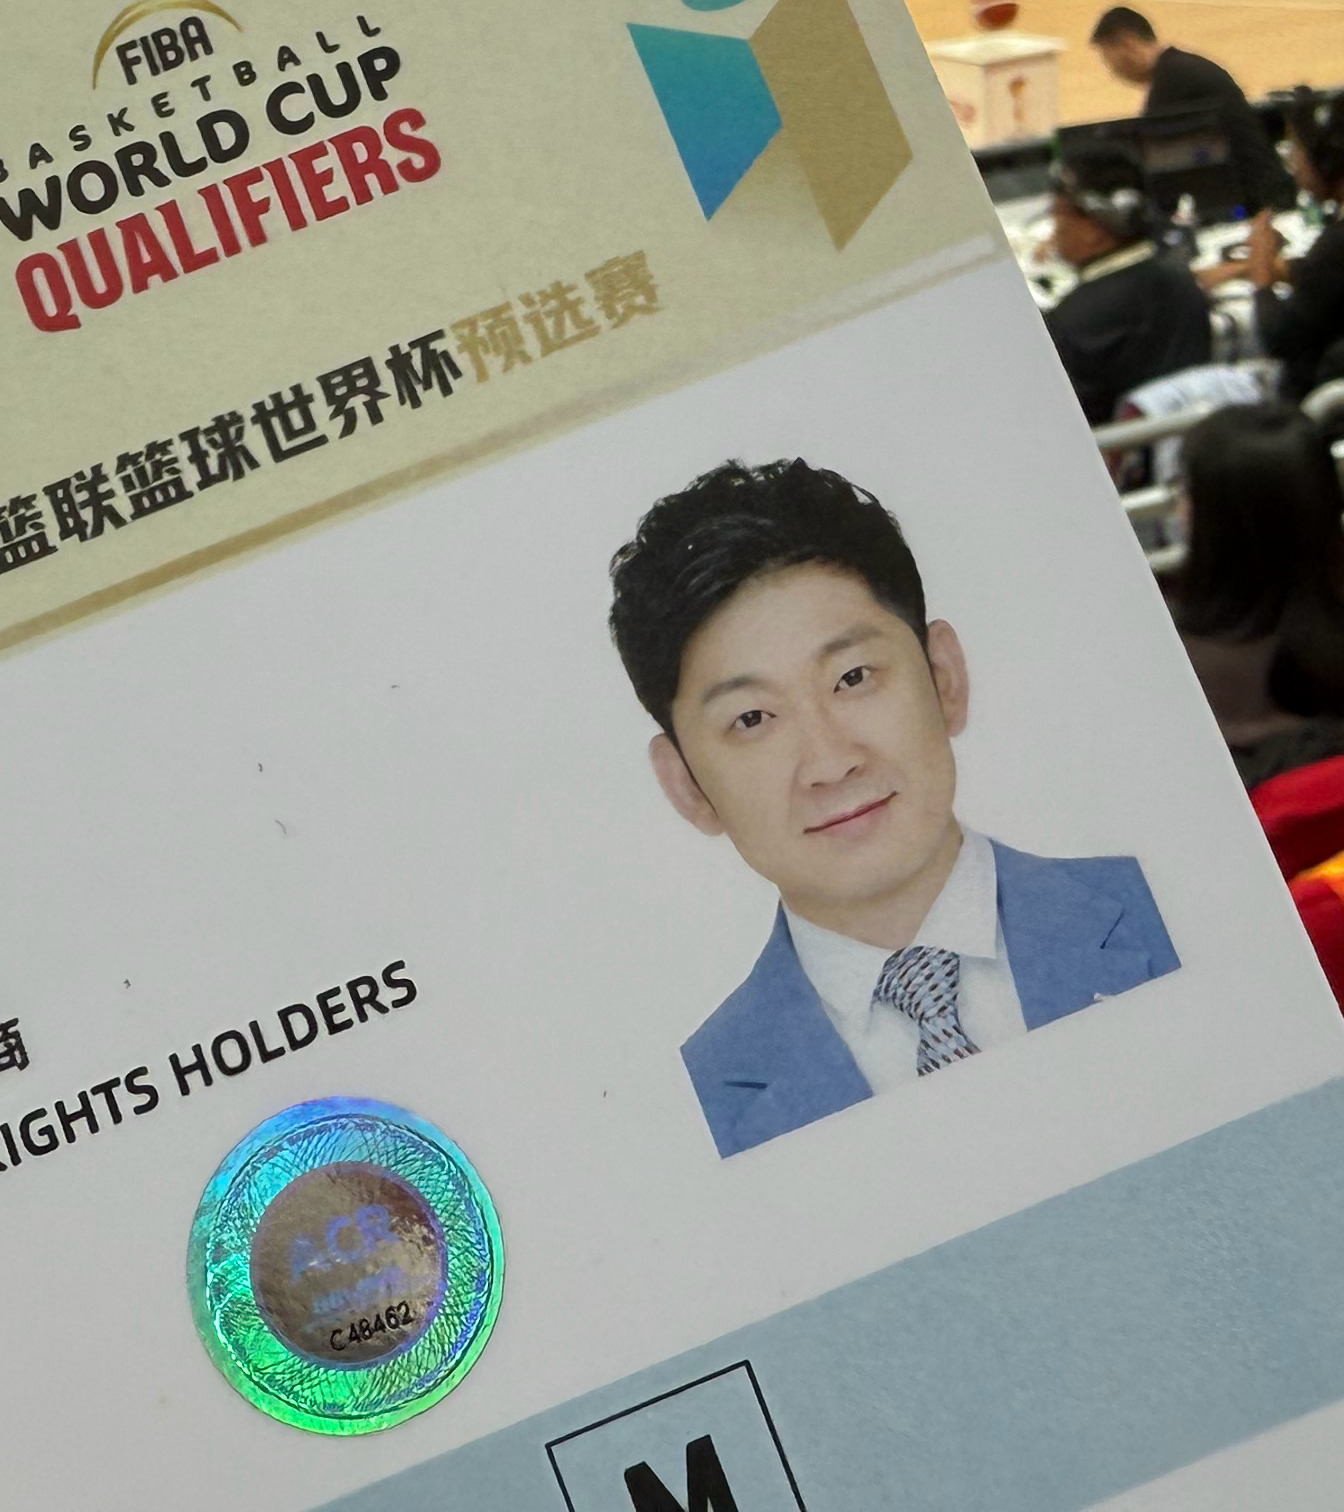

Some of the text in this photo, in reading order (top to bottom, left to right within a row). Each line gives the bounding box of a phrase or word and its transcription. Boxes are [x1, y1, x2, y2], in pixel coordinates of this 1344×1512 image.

[116, 16, 214, 85] FIBA
[265, 46, 402, 135] CUP
[14, 107, 442, 333] QUALIFIERS
[168, 959, 418, 1097] HOLDERS
